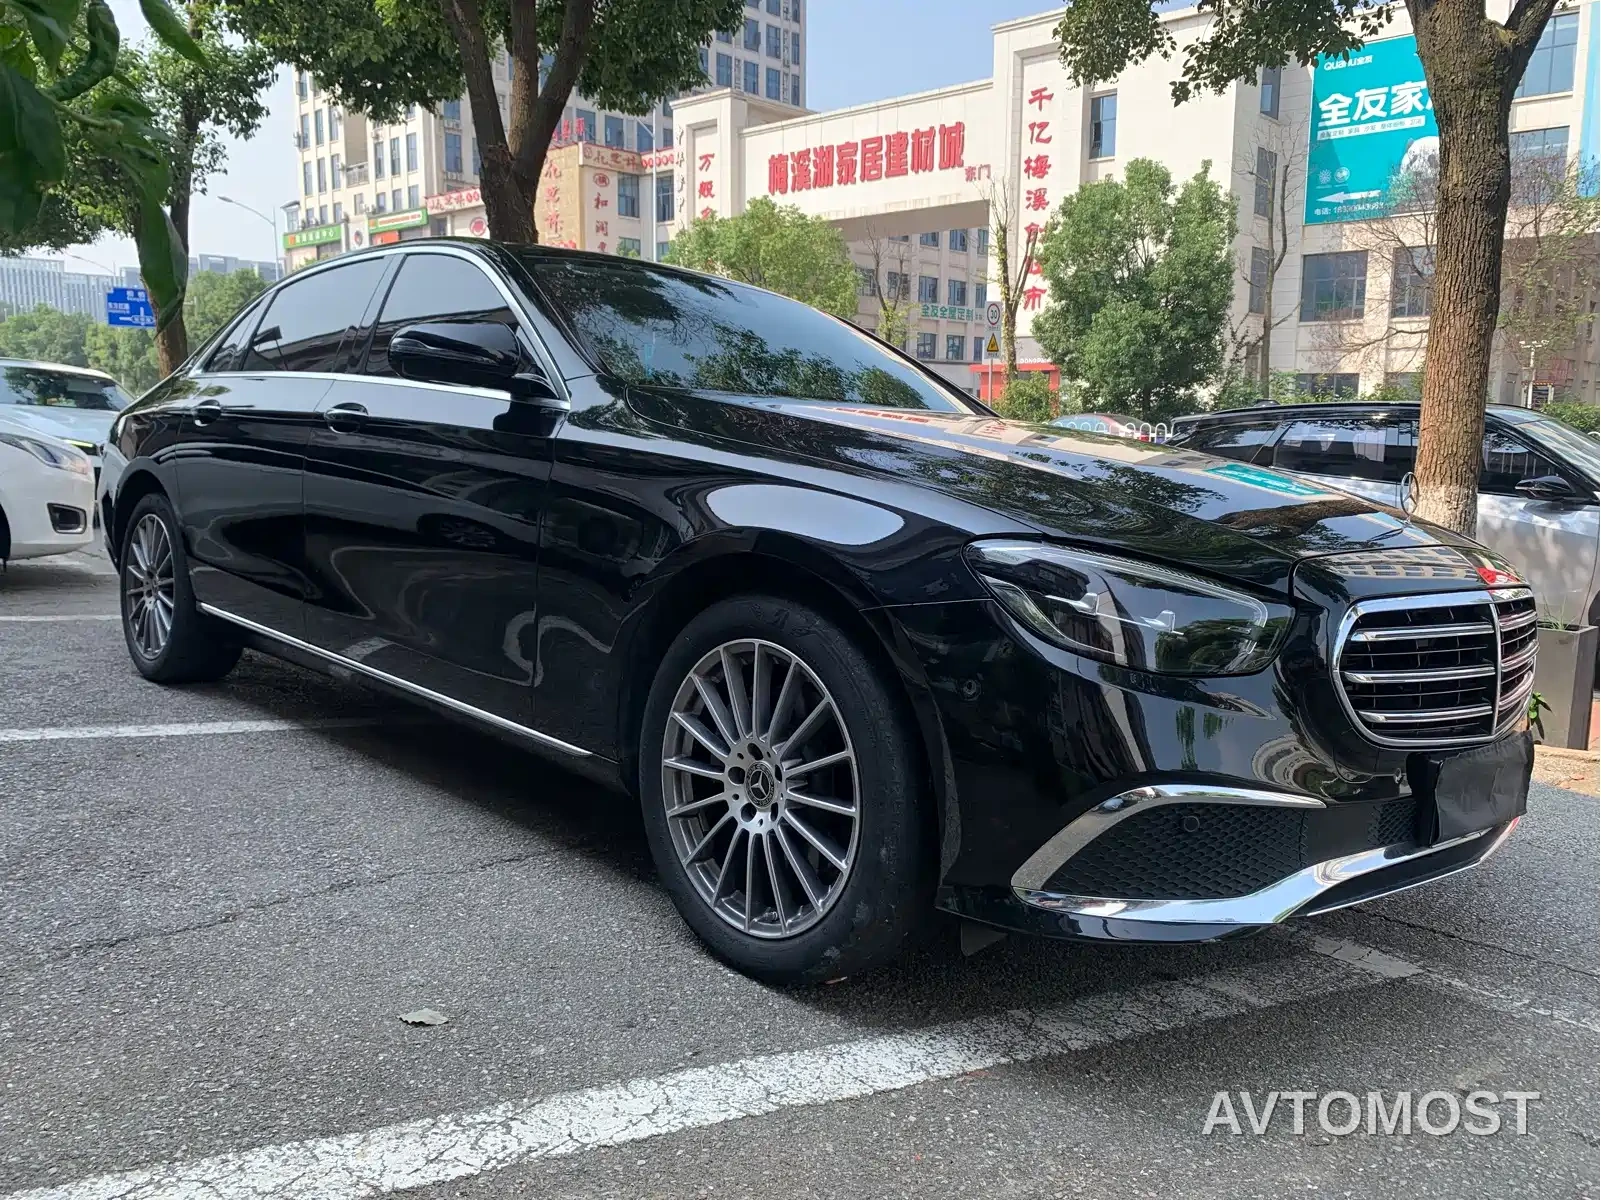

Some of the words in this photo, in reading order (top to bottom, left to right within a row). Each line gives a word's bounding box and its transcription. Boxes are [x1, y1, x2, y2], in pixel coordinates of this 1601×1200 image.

[1318, 80, 1432, 127] 全友家
[768, 121, 965, 196] 梅溪湖家居建材城
[965, 164, 991, 182] 东门
[921, 304, 974, 322] 全友全屋定制
[990, 309, 997, 320] 30
